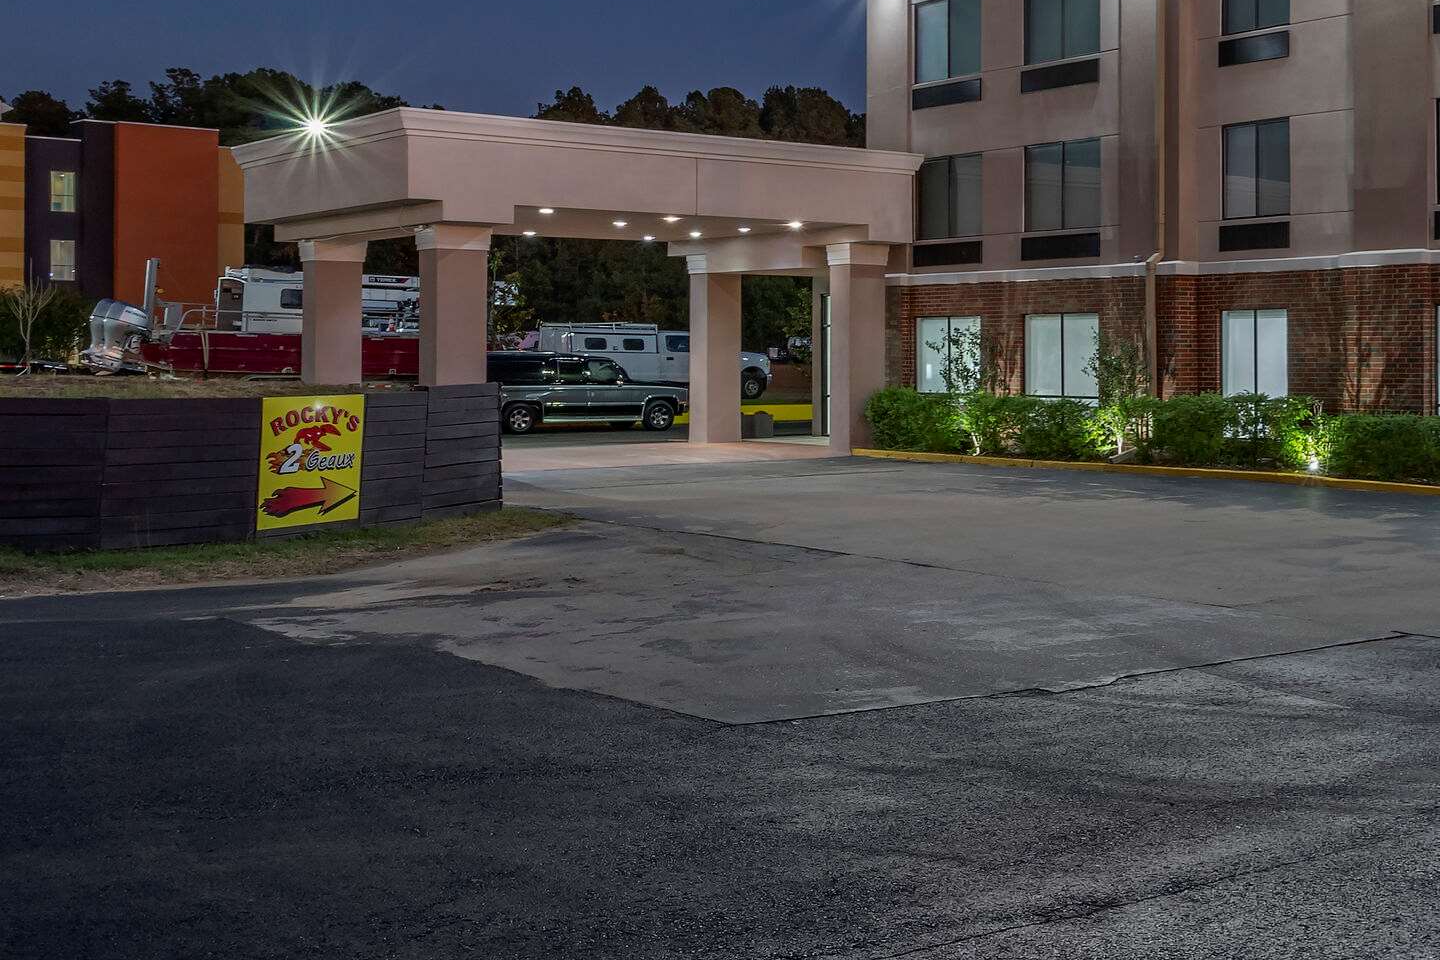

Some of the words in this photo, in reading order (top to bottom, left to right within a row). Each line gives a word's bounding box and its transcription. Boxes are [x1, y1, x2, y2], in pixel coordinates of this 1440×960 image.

[270, 406, 360, 436] ROCKY'S
[279, 443, 303, 475] 2
[306, 450, 355, 472] Geaux
